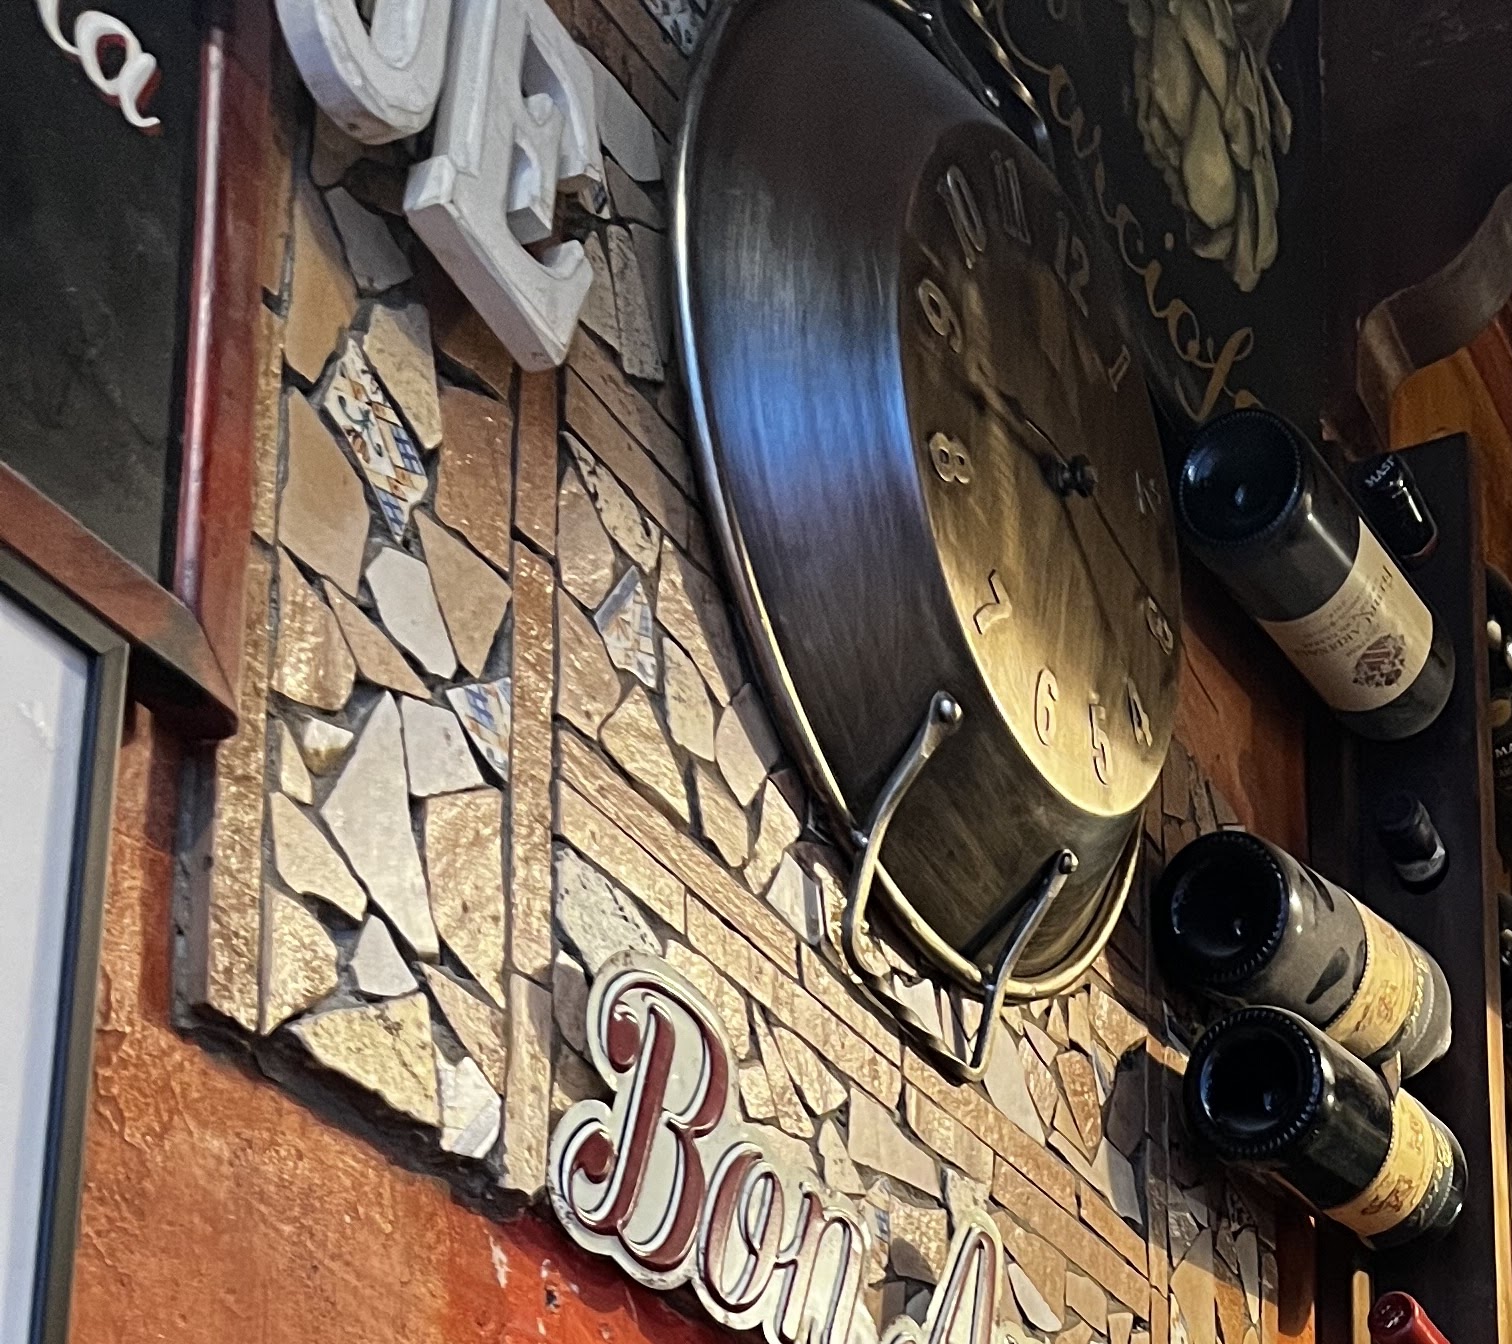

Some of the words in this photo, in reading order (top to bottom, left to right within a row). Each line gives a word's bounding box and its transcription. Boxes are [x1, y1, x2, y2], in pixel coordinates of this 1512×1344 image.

[928, 431, 973, 486] 8
[1034, 667, 1058, 747] 6
[1087, 688, 1113, 786] 5
